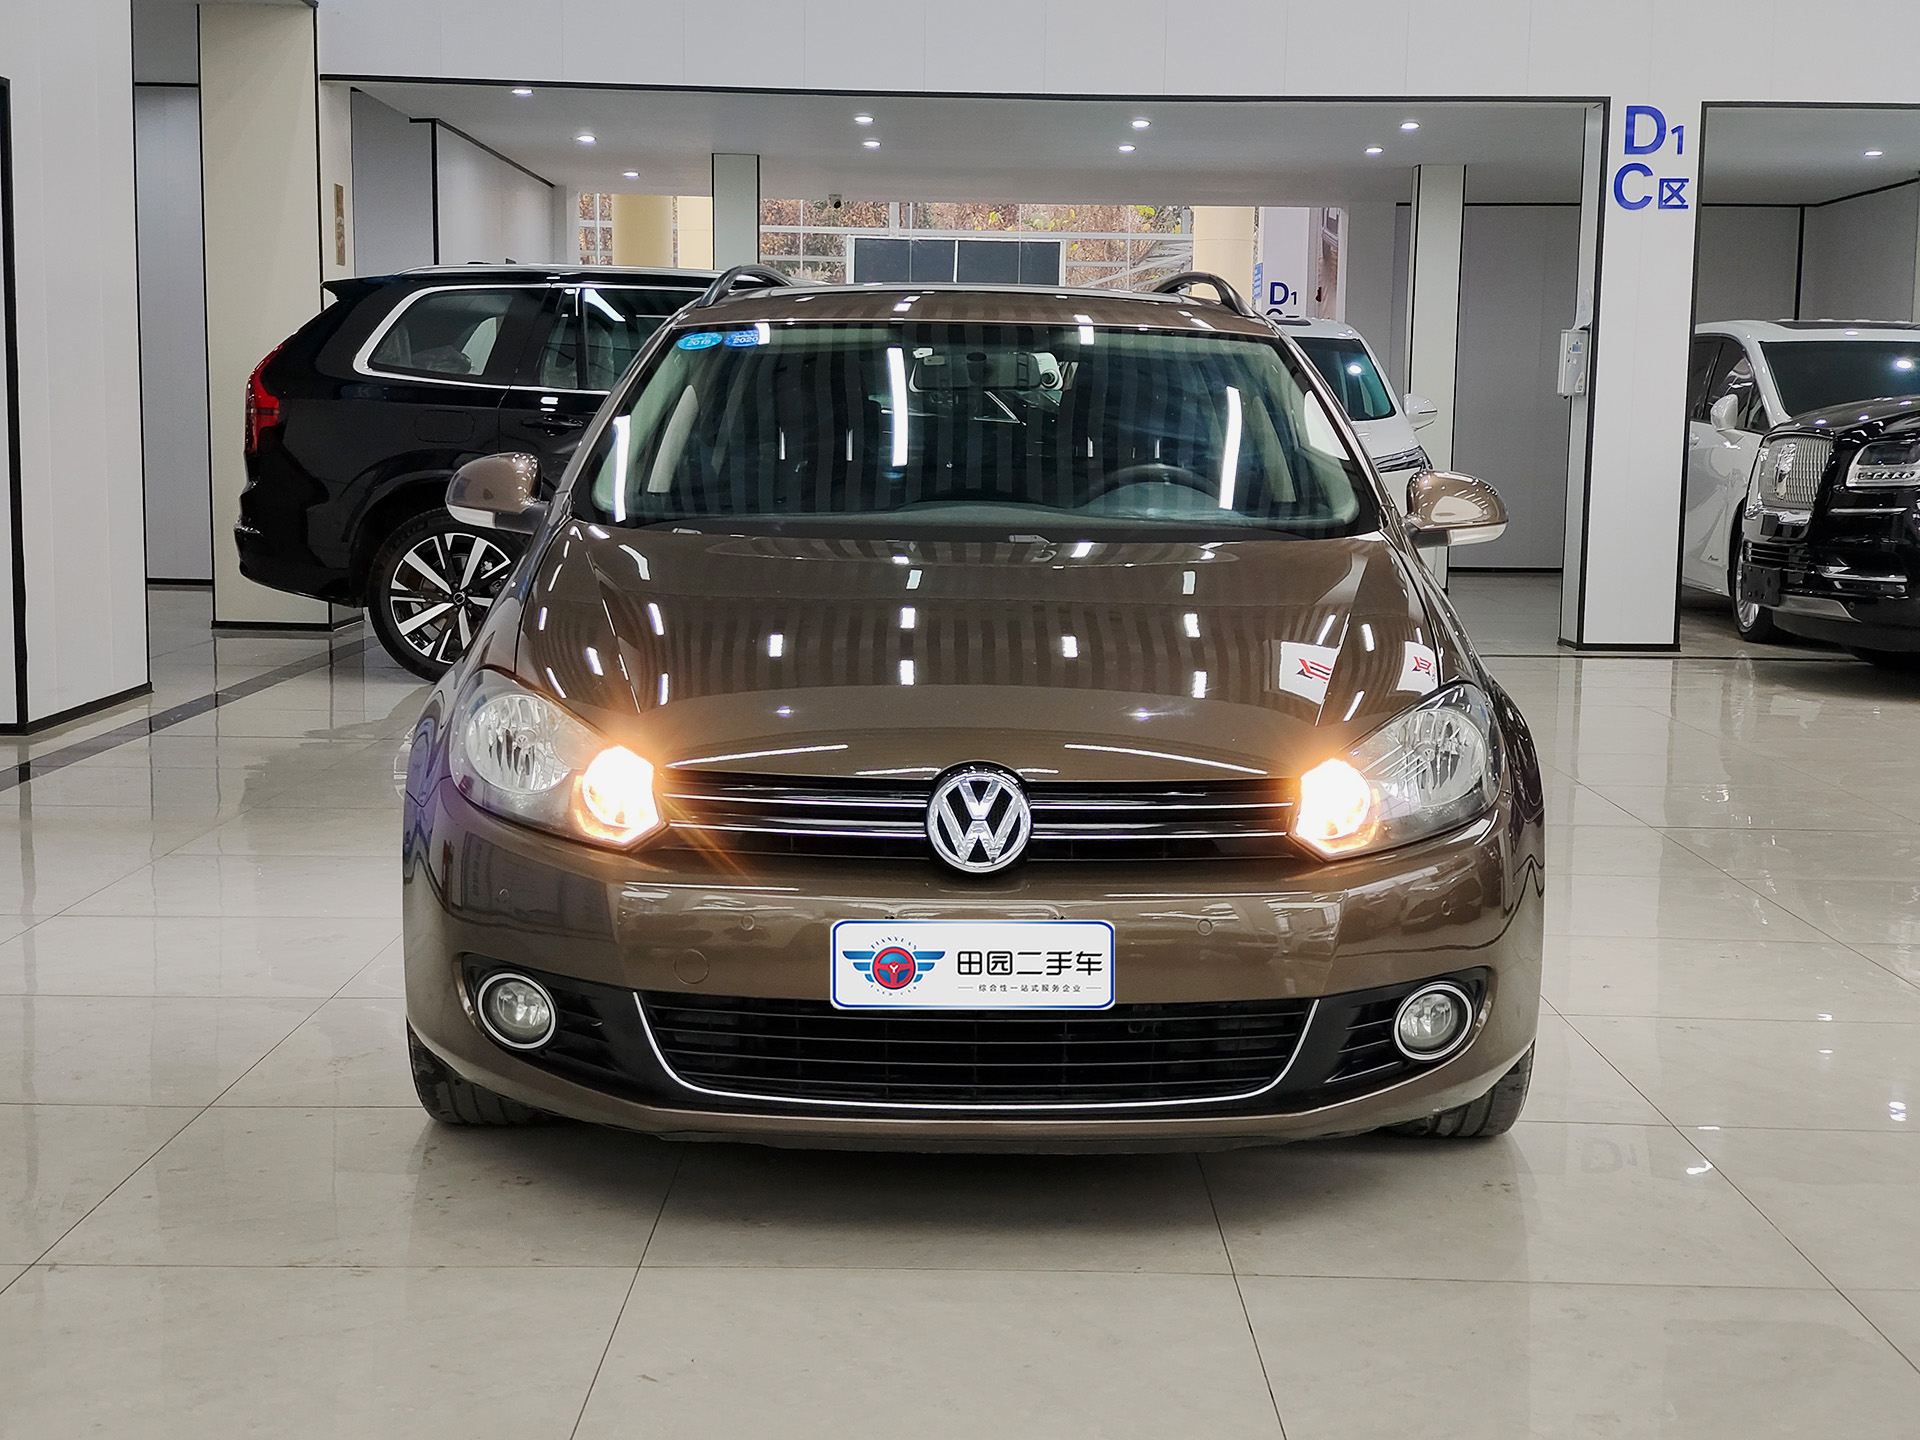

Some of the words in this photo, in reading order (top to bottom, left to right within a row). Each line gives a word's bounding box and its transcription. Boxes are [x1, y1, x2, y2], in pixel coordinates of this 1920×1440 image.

[1624, 106, 1684, 155] D1
[1614, 163, 1689, 210] C区
[1270, 282, 1297, 305] D1
[732, 336, 759, 345] 2020
[957, 950, 1103, 976] 田园二手车
[978, 984, 1082, 993] 综合性一站式服务企业
